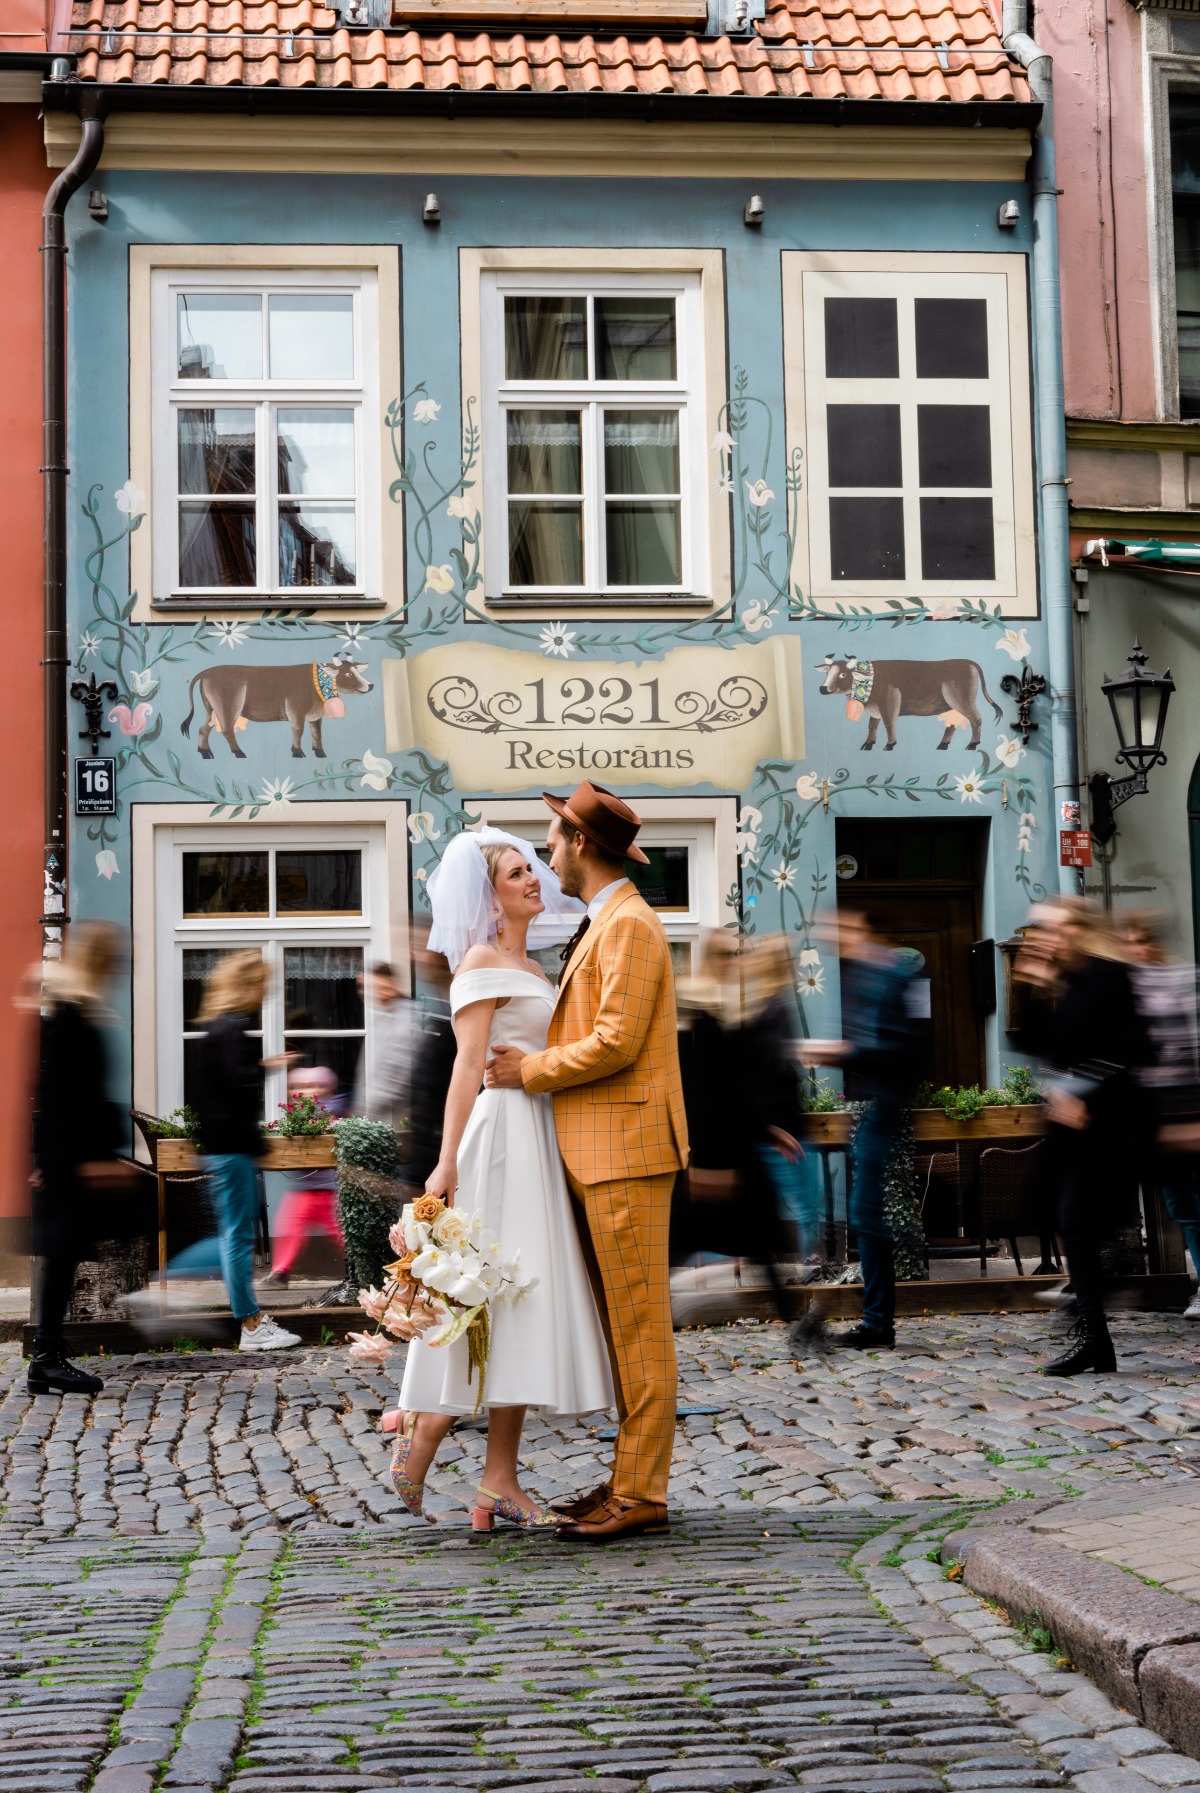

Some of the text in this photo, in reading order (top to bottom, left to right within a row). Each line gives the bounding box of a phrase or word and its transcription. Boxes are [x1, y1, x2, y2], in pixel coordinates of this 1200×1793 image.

[524, 677, 670, 725] 1221
[505, 740, 695, 770] Restorāns
[82, 770, 109, 792] 16
[1077, 839, 1088, 847] 100
